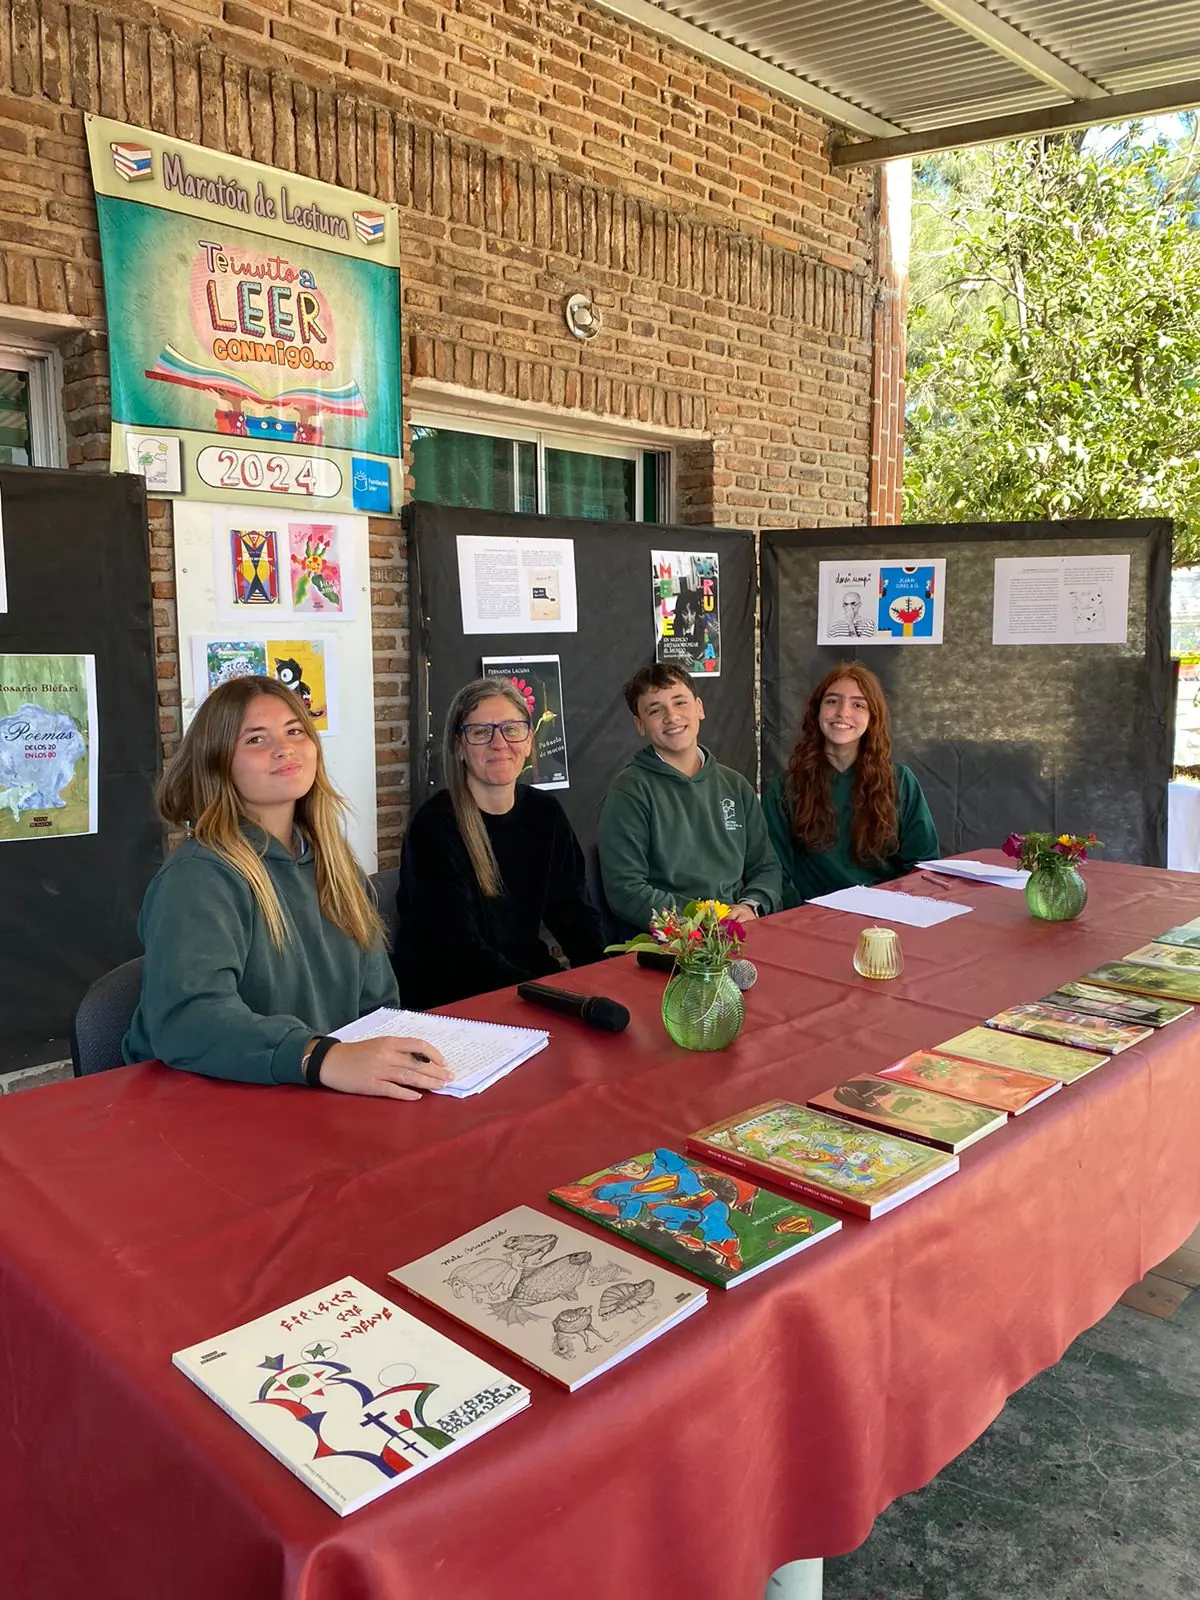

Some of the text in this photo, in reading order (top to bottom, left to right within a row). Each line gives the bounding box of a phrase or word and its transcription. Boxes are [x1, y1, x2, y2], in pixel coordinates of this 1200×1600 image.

[162, 151, 350, 240] Maratón de Lectura
[198, 240, 317, 290] Te invito a
[206, 279, 328, 344] LEER
[217, 449, 318, 496] 2024
[5, 721, 74, 742] Poemas
